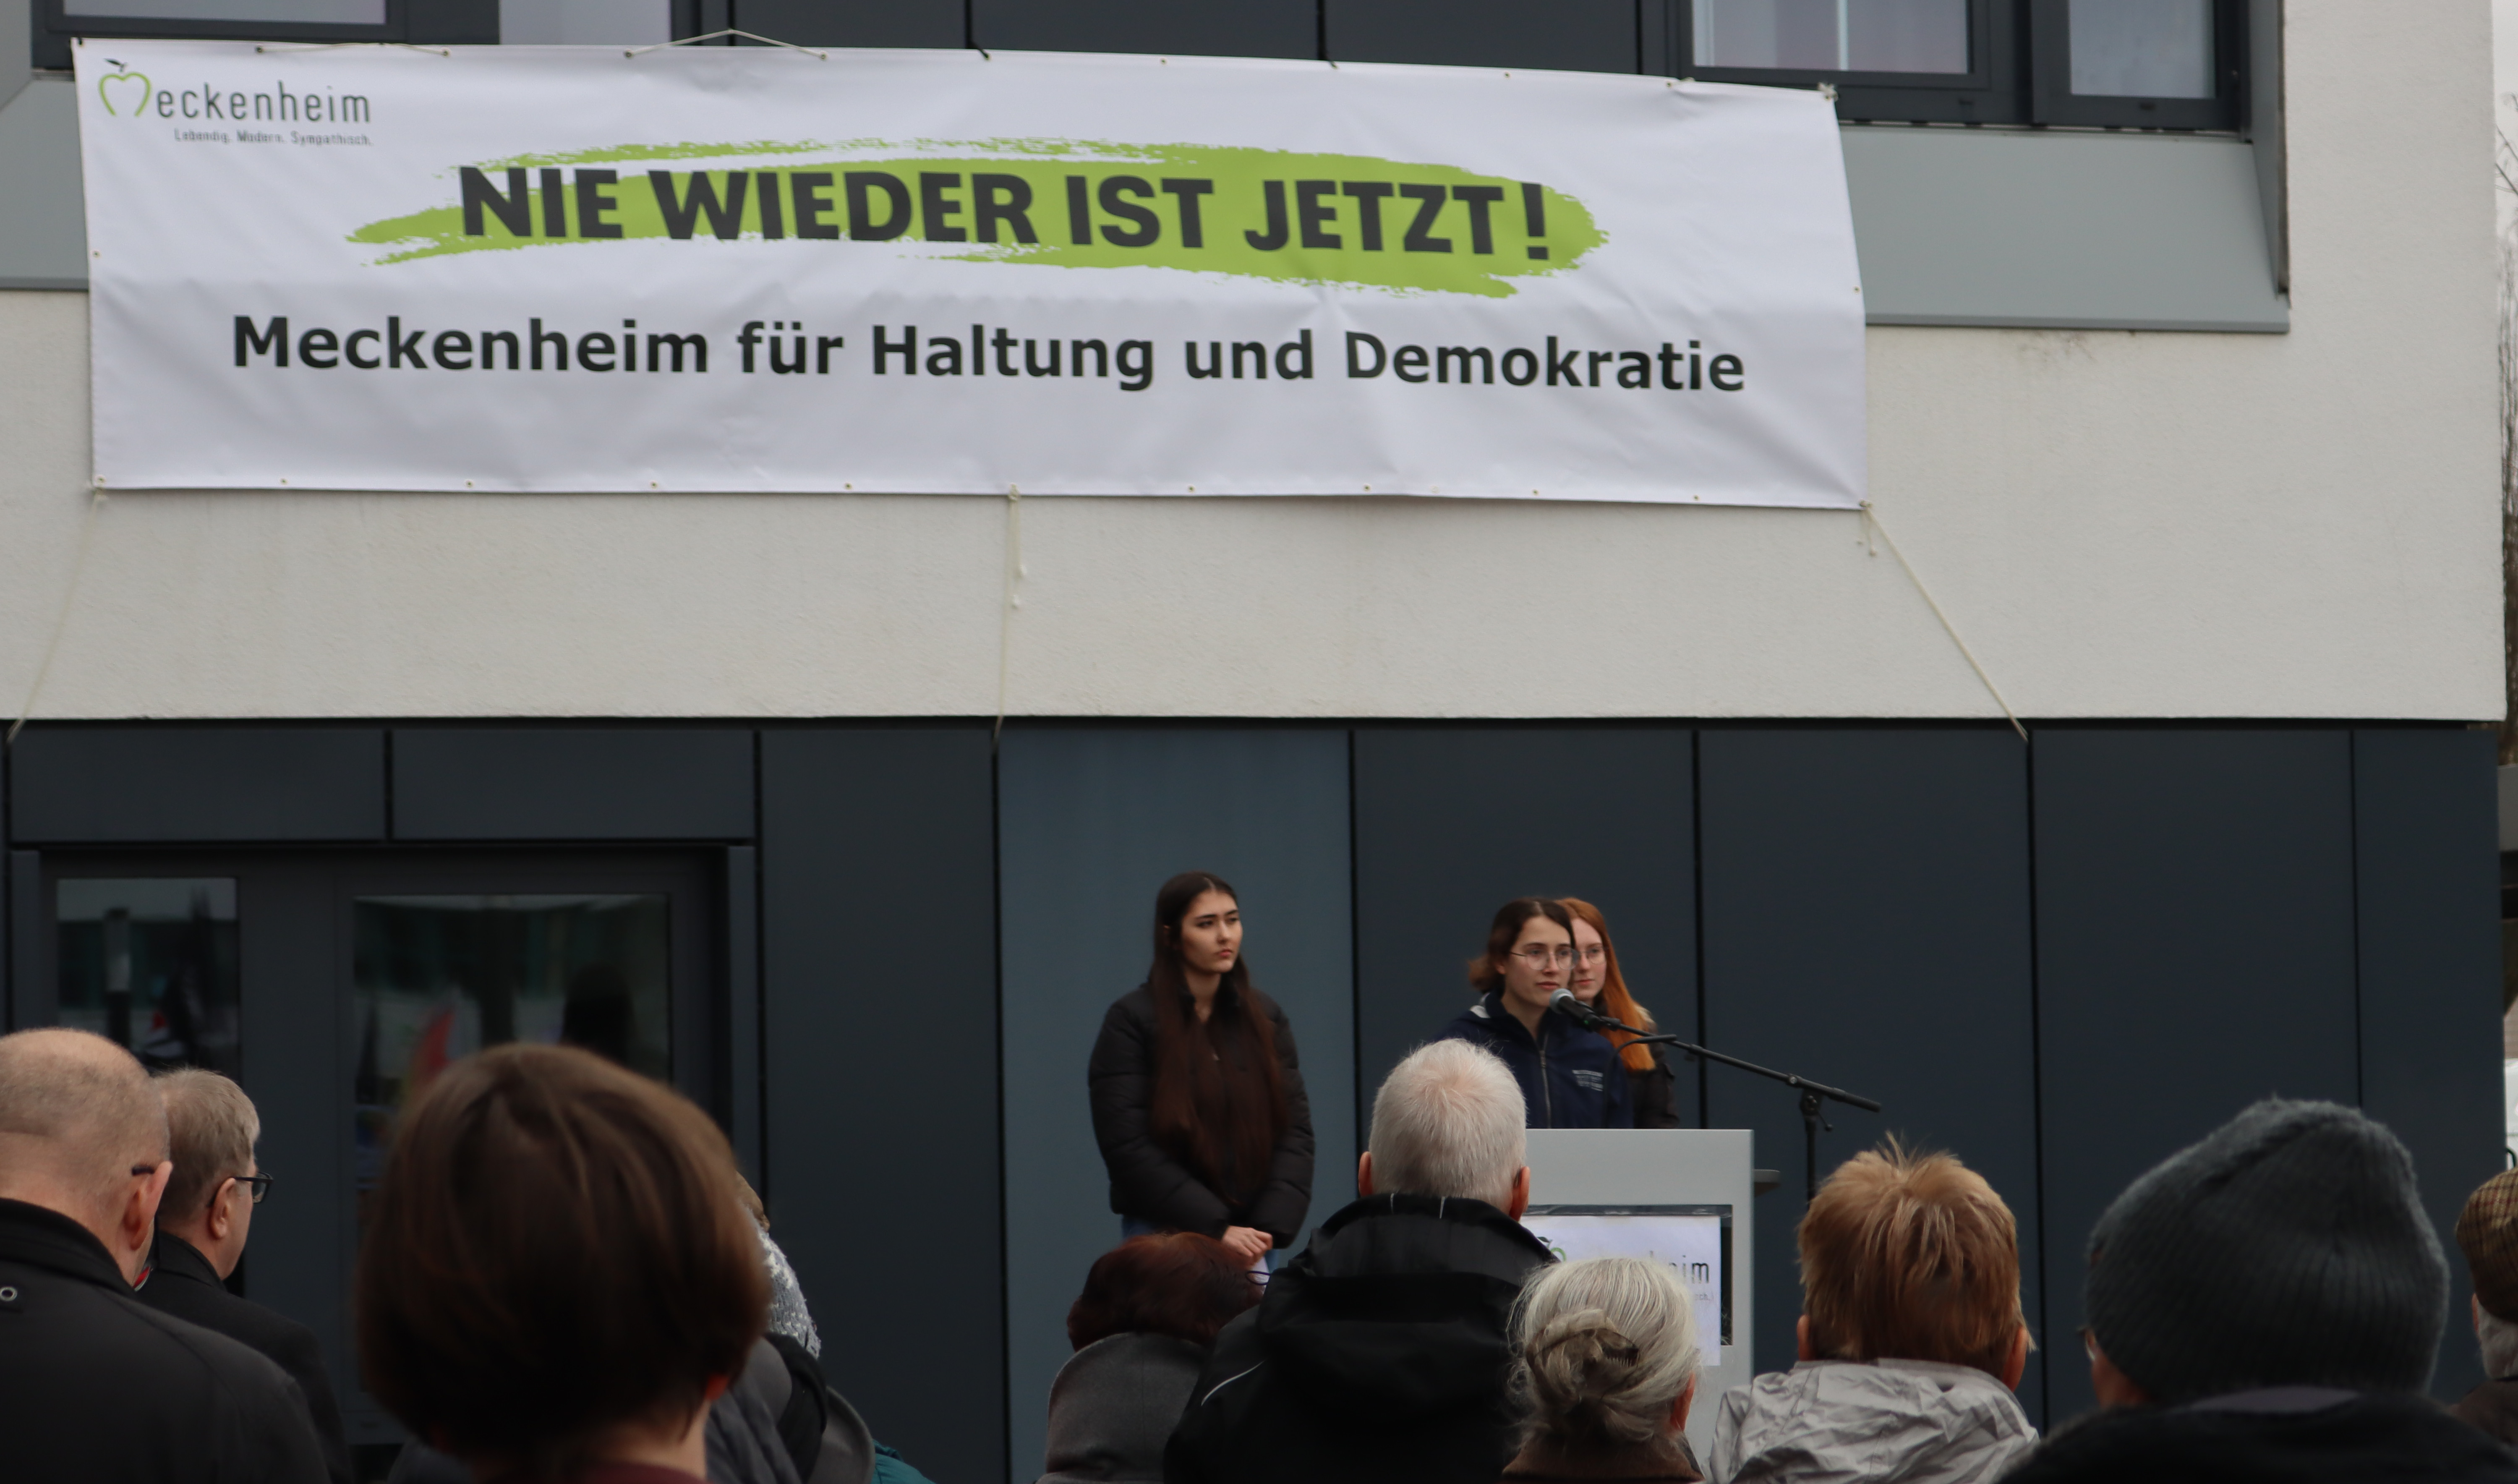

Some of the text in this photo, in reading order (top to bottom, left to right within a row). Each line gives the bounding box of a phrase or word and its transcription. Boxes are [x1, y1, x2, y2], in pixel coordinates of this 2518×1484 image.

[174, 128, 373, 146] Lebendig. Modern. Sympathisch.
[460, 166, 623, 239] NIE
[648, 170, 1039, 244] WIEDER
[1066, 175, 1214, 248] IST
[234, 316, 1743, 392] Meckenheim für Haltung und Demokratie
